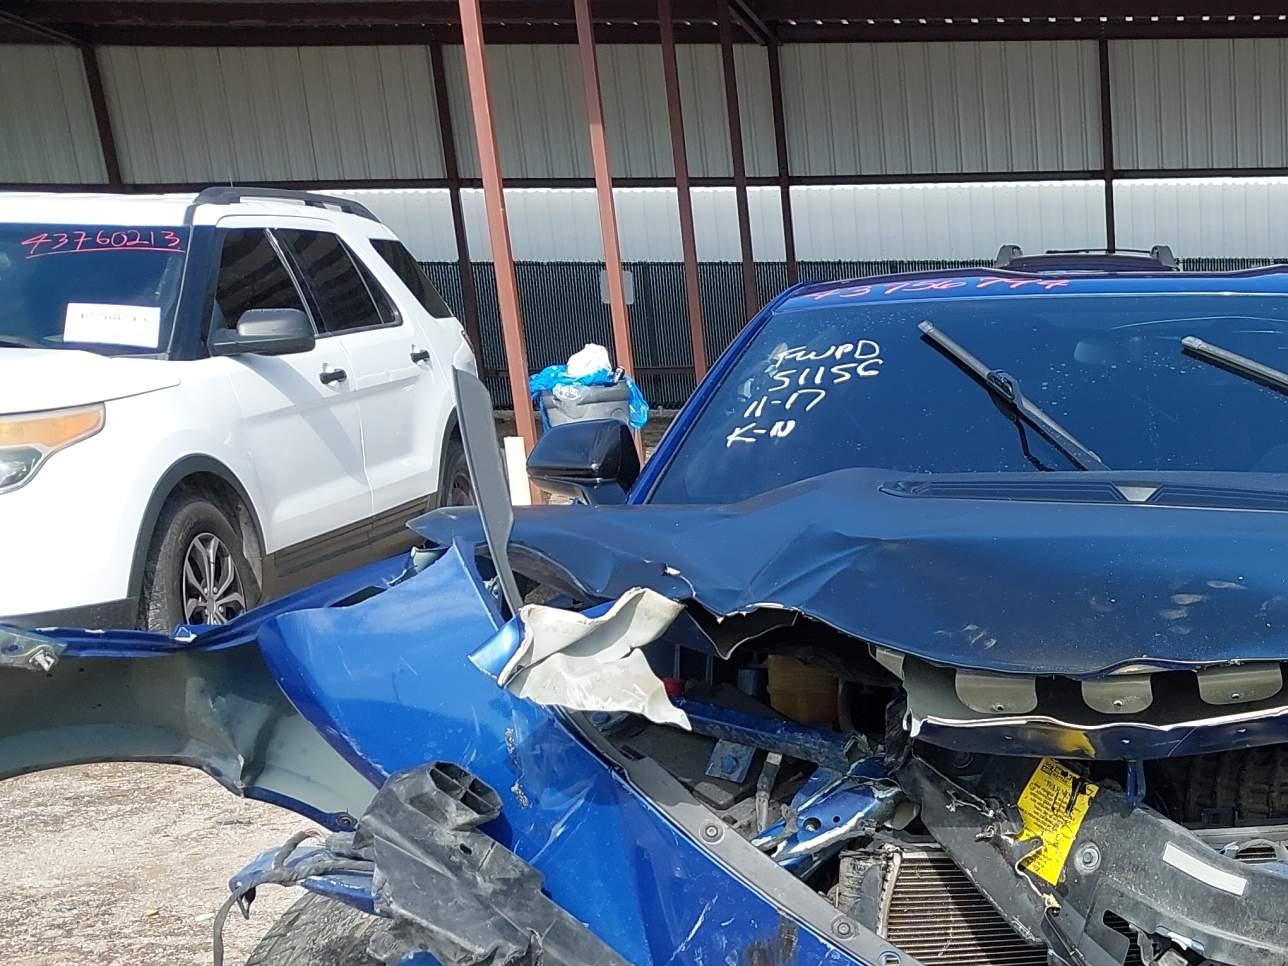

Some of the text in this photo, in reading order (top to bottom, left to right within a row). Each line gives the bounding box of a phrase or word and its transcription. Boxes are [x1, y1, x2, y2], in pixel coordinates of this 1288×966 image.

[20, 229, 181, 255] 43760213
[768, 359, 884, 392] 51156
[743, 389, 827, 418] 11-17
